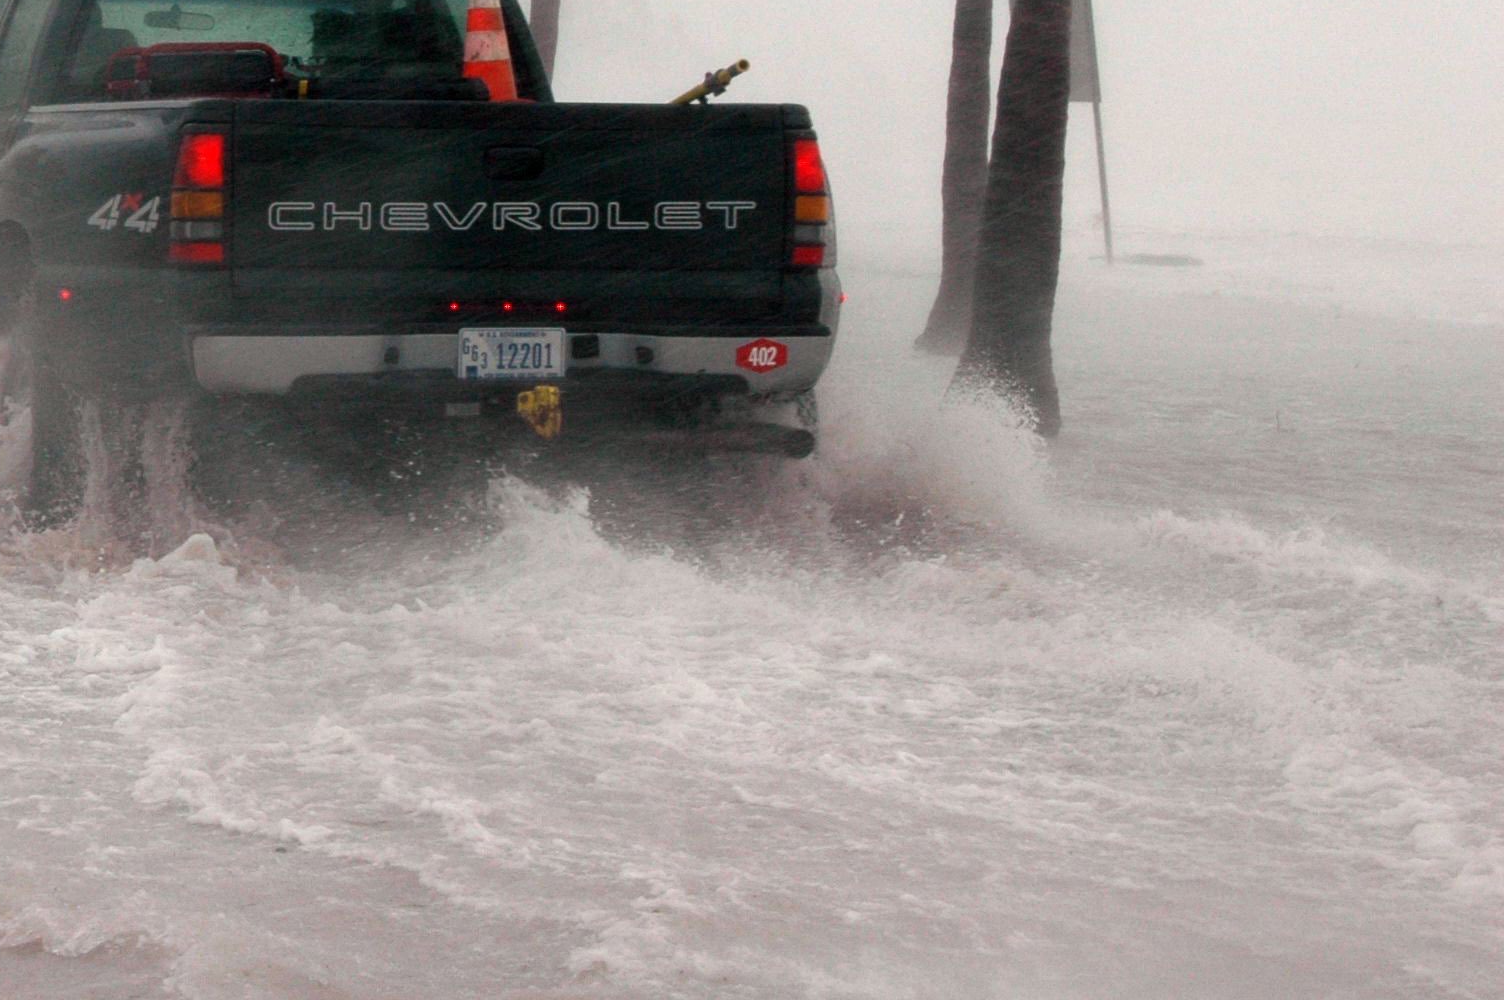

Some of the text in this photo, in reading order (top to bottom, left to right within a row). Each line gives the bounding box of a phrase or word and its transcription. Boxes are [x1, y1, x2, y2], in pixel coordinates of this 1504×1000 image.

[268, 200, 756, 231] CHEVROLET
[497, 343, 553, 369] 12201
[748, 346, 778, 367] 402
